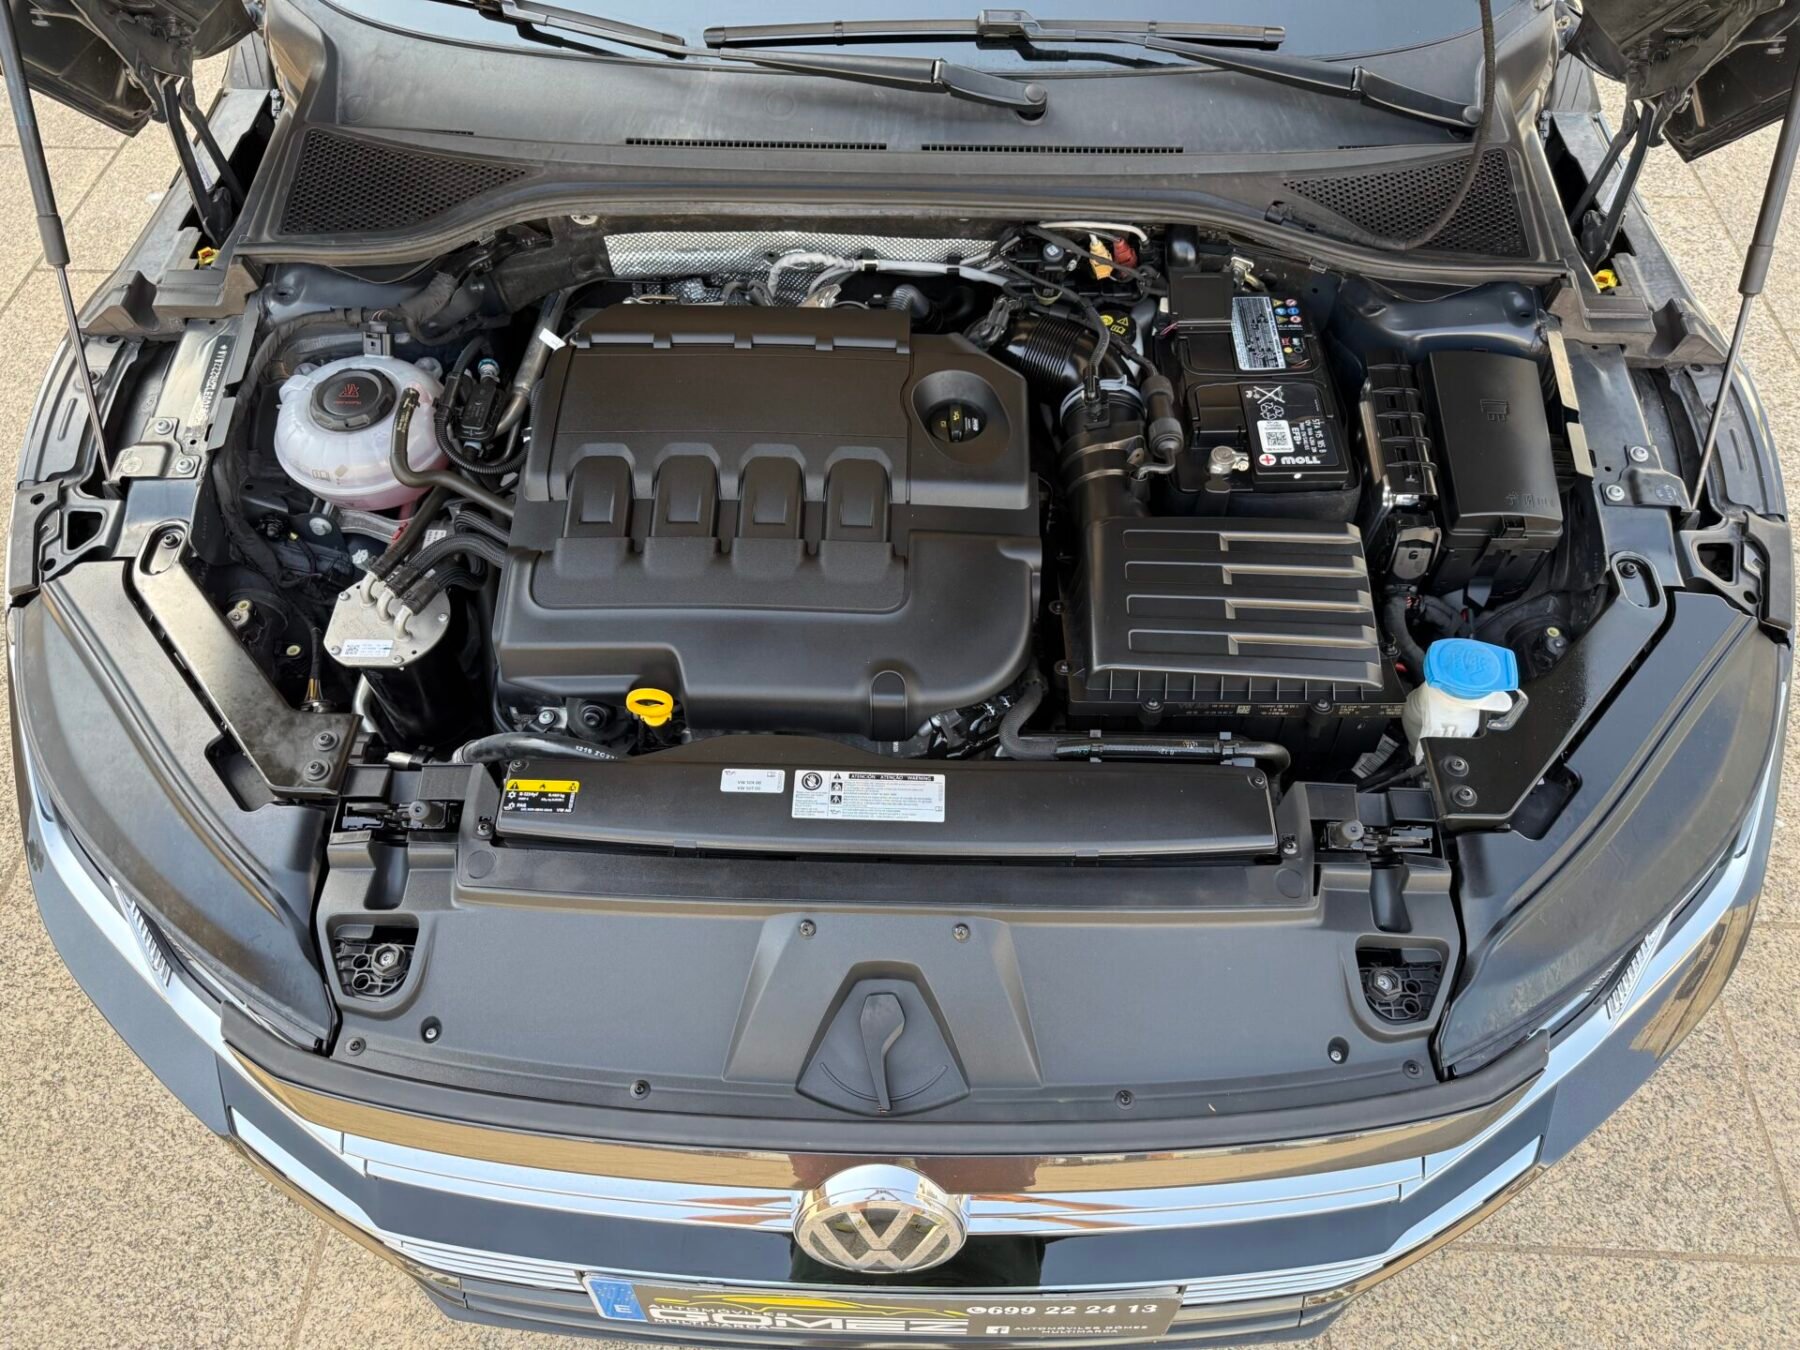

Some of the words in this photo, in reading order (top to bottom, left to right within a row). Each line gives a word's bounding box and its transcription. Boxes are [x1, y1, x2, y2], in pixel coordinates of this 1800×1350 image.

[613, 1304, 632, 1314] E
[987, 1306, 1036, 1315] 699
[1044, 1305, 1077, 1315] 22
[1084, 1304, 1117, 1314] 24
[1128, 1304, 1158, 1313] 13
